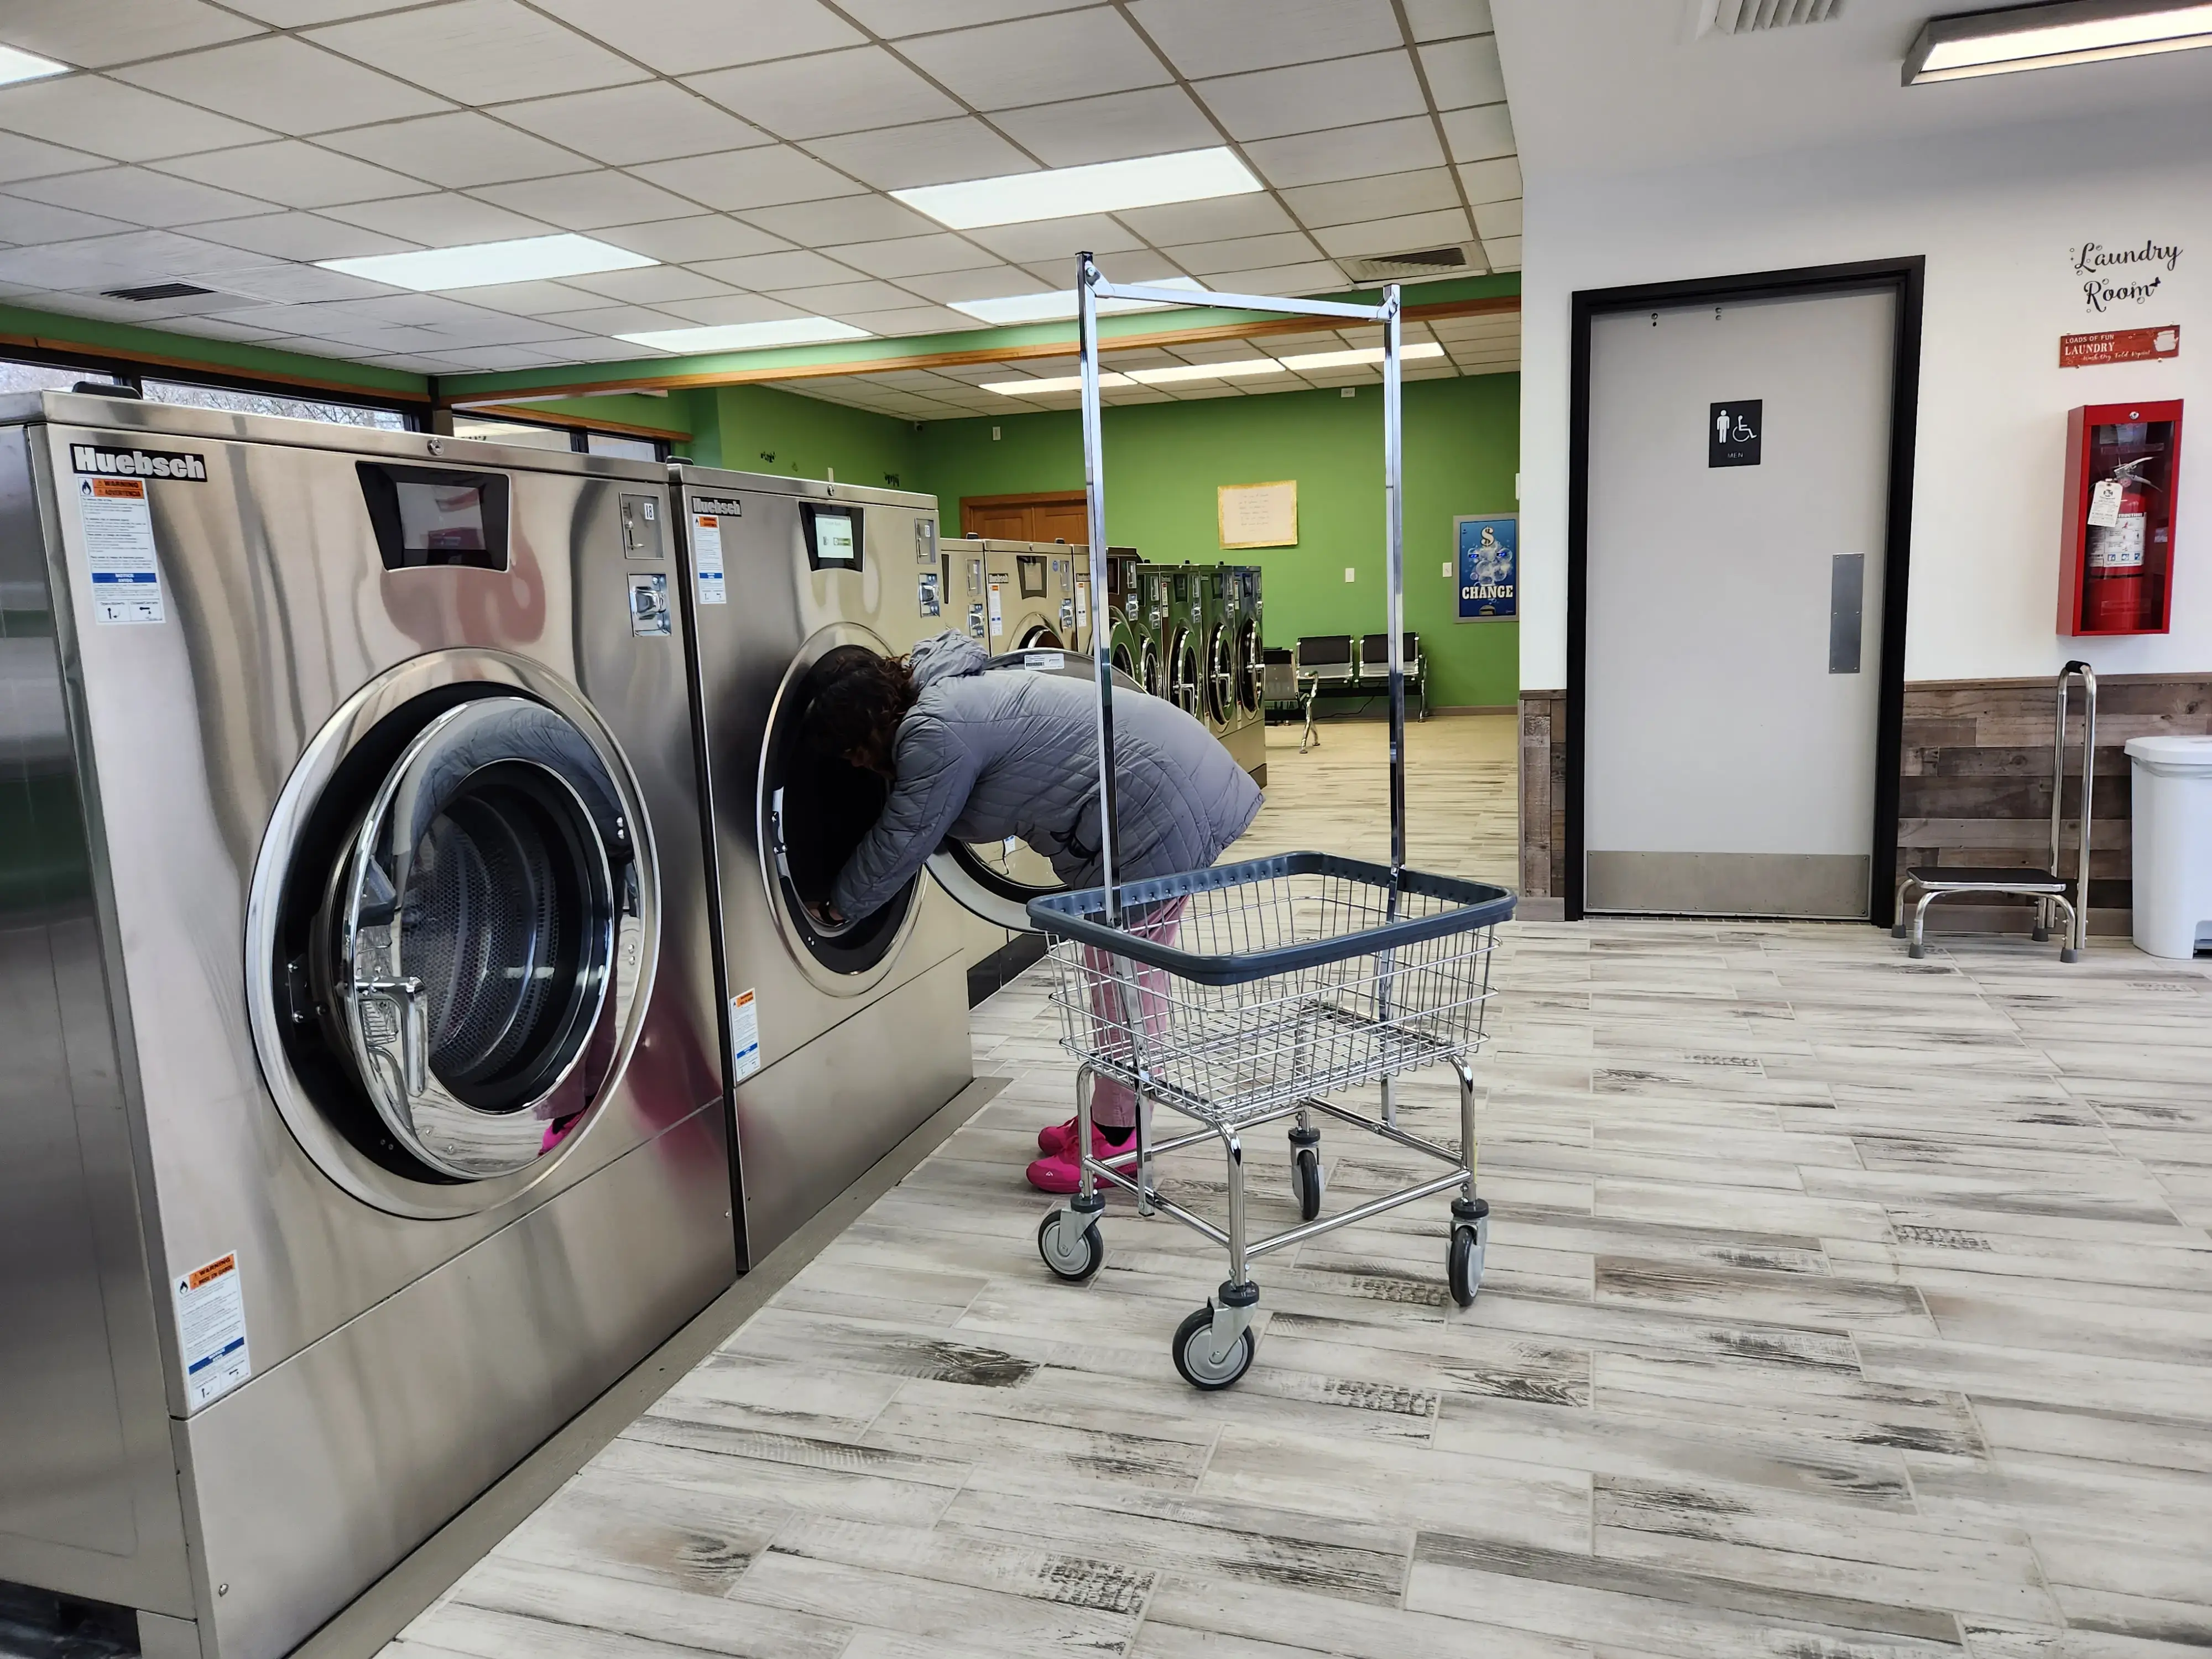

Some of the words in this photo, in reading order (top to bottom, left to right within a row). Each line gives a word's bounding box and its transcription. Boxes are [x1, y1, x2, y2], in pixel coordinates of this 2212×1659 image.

[2074, 240, 2183, 273] Laundry
[2084, 280, 2155, 312] Room
[2065, 335, 2087, 344] LOADS
[2065, 342, 2115, 356] LAUNDRY
[74, 446, 205, 479] Huebsch
[103, 480, 139, 488] WARNING
[646, 505, 653, 518] 18
[692, 498, 741, 515] Huebsch
[1481, 525, 1494, 548] $
[1462, 585, 1513, 599] CHANGE
[199, 1257, 231, 1276] WARNING
